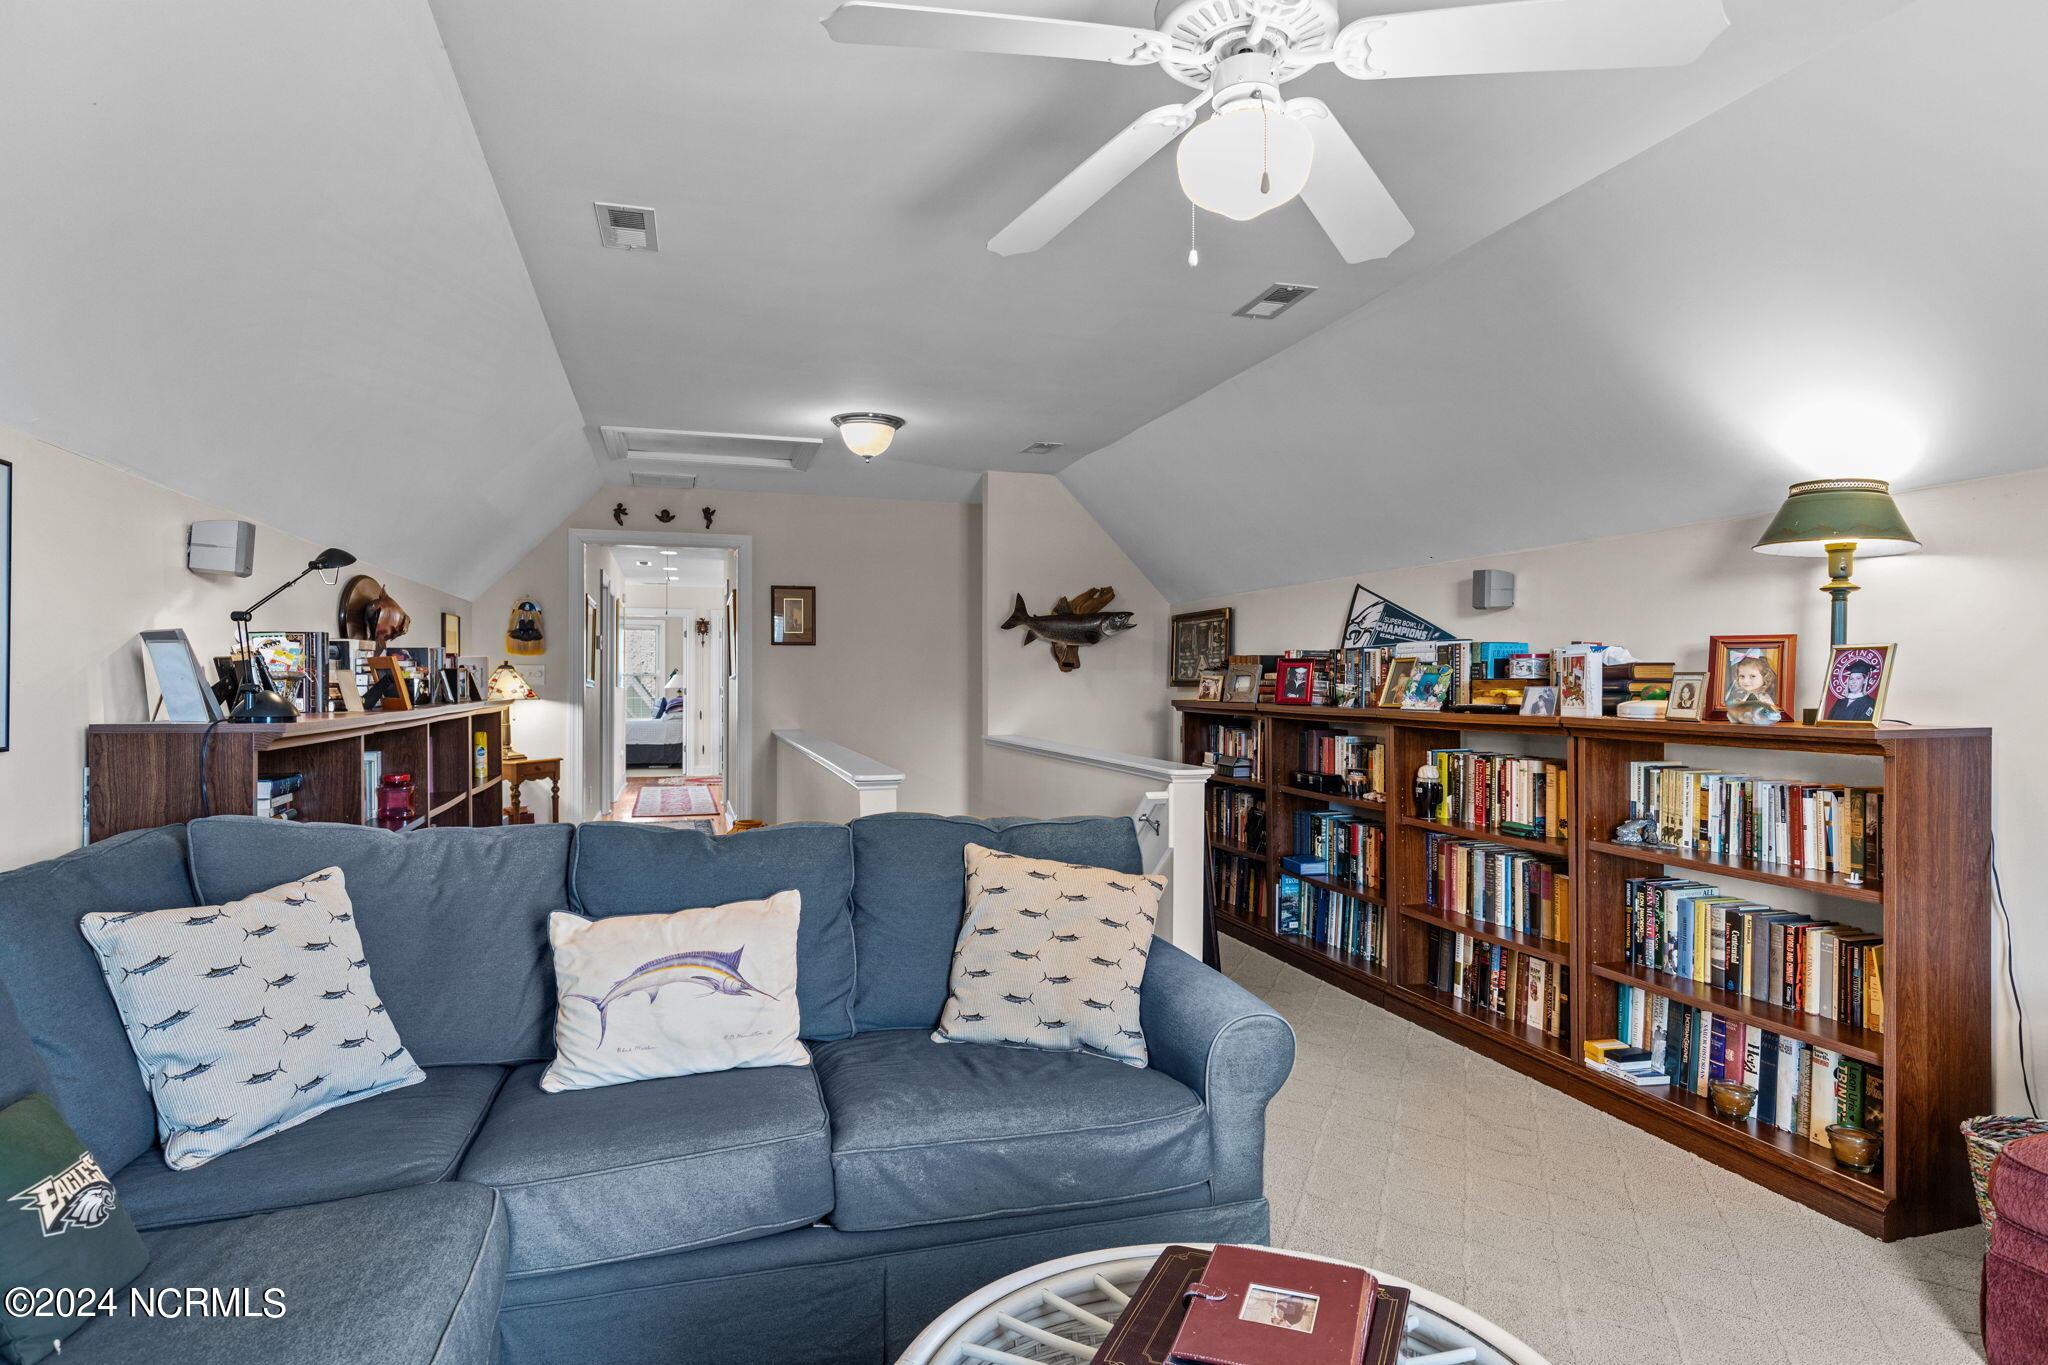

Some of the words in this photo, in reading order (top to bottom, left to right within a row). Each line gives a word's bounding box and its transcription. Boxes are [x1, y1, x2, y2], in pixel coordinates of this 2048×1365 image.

[1375, 621, 1428, 641] CHAMPIONS
[1383, 617, 1402, 625] SUPER
[1402, 620, 1417, 629] BOWL
[1833, 650, 1880, 675] DICKINSON
[1646, 906, 1654, 937] MUSIAL
[1731, 930, 1740, 964] Centennial
[1499, 969, 1507, 990] MARX
[1848, 1066, 1859, 1091] Leon
[1837, 1065, 1848, 1122] TRINITY
[1848, 1093, 1857, 1111] Uris
[10, 1152, 111, 1232] EAGLES
